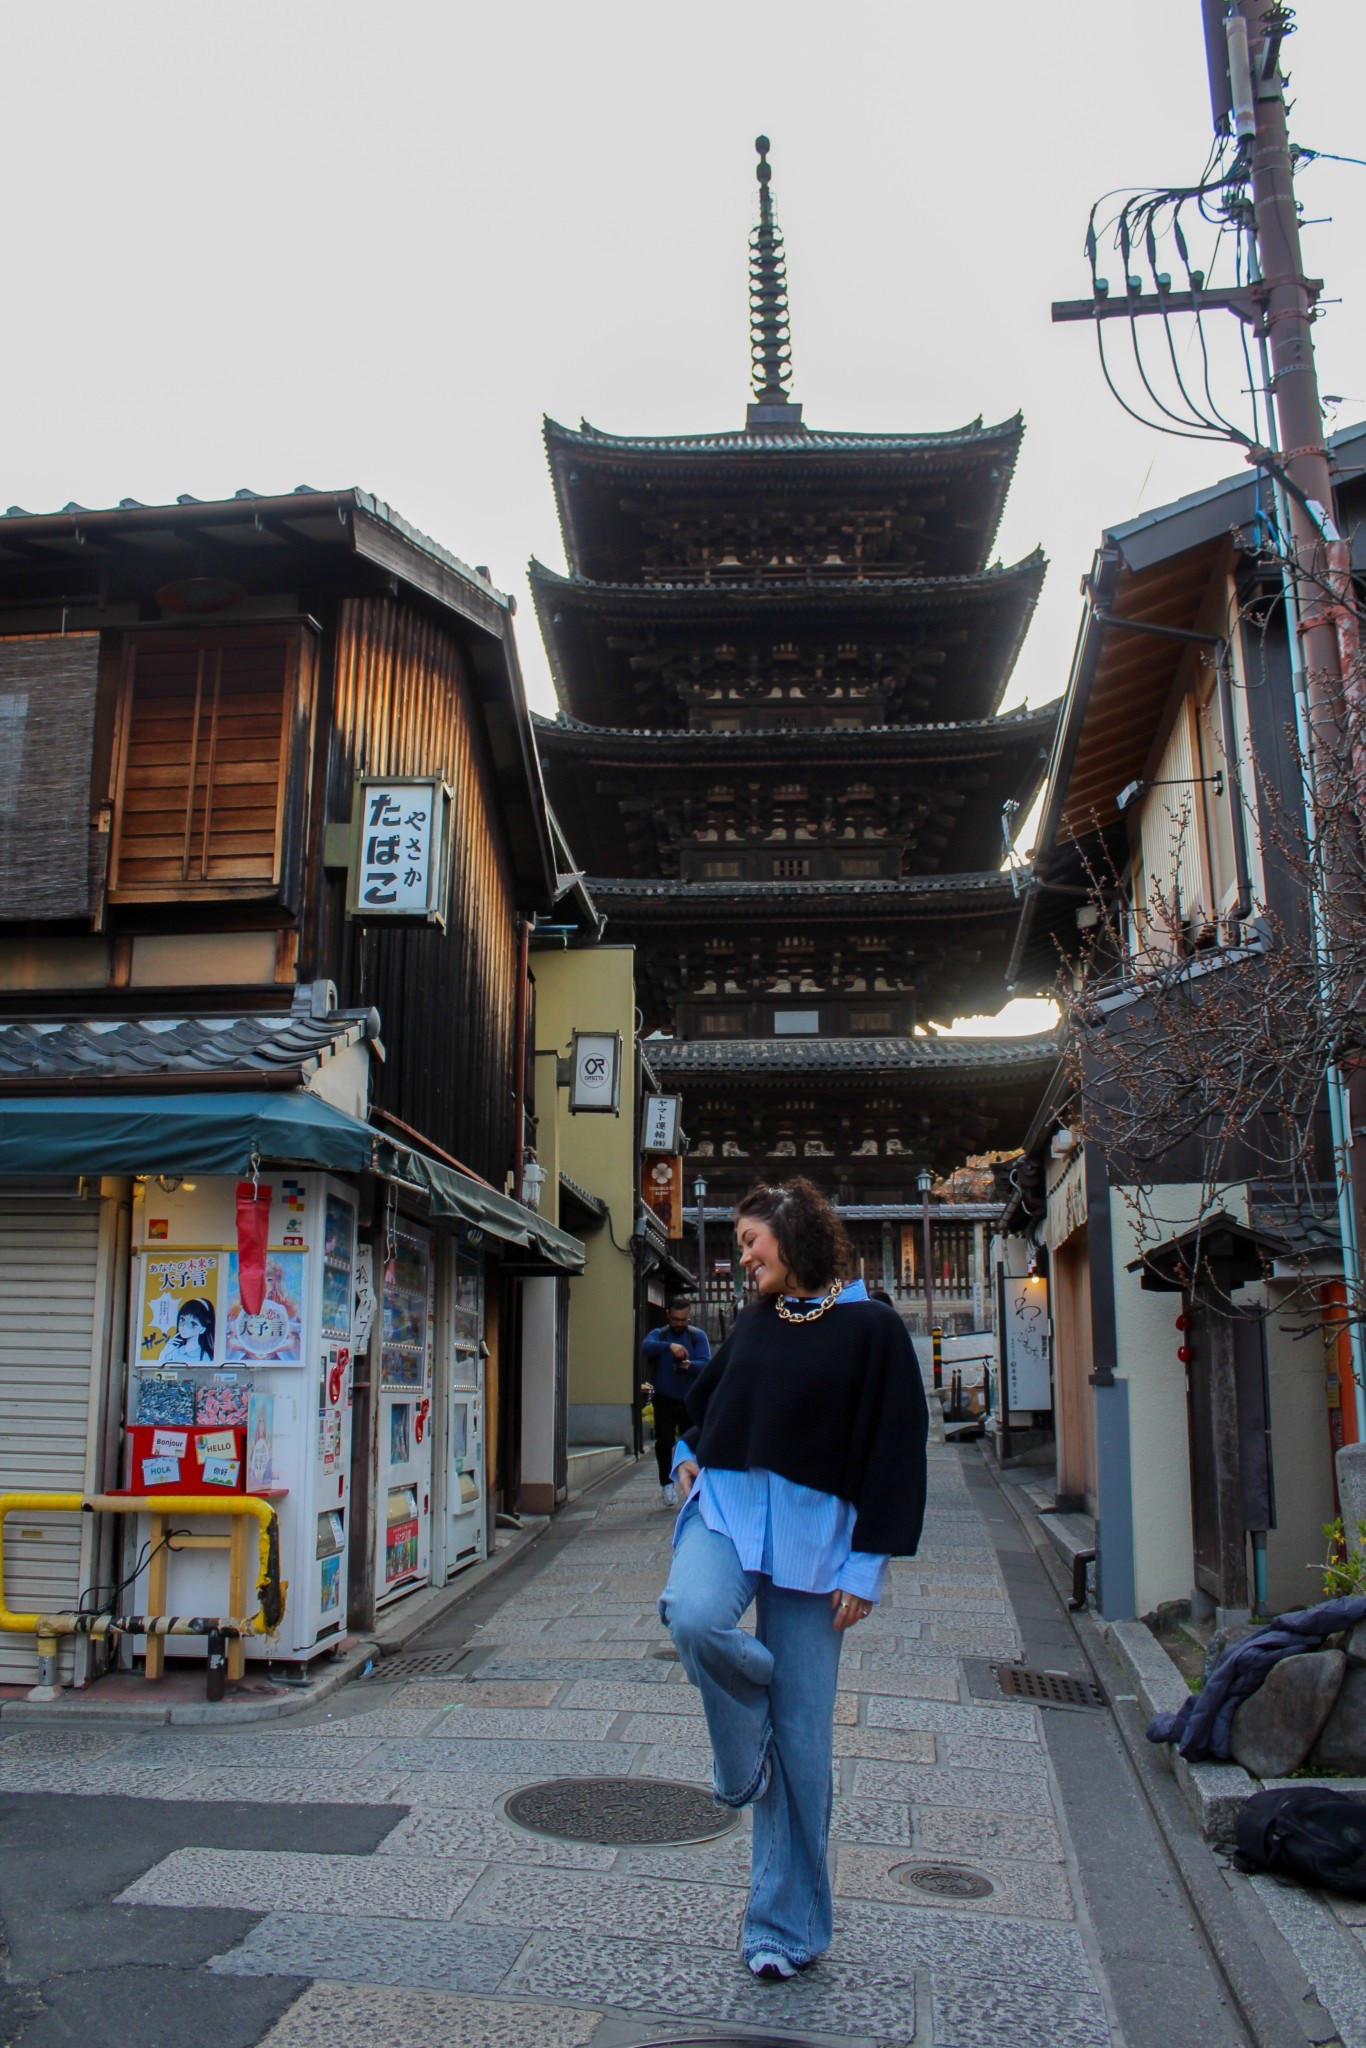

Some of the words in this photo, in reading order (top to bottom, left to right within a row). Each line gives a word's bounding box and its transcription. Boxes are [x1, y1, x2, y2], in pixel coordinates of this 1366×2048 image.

[364, 794, 401, 905] たばこ
[404, 811, 427, 888] やさか
[149, 1258, 216, 1274] あなたの未来を
[160, 1269, 206, 1290] 大予言
[239, 1320, 284, 1337] 大予言
[156, 1438, 184, 1448] Bonjour
[206, 1442, 232, 1453] HELLO
[150, 1466, 171, 1475] HOLA
[213, 1466, 228, 1476] 你好
